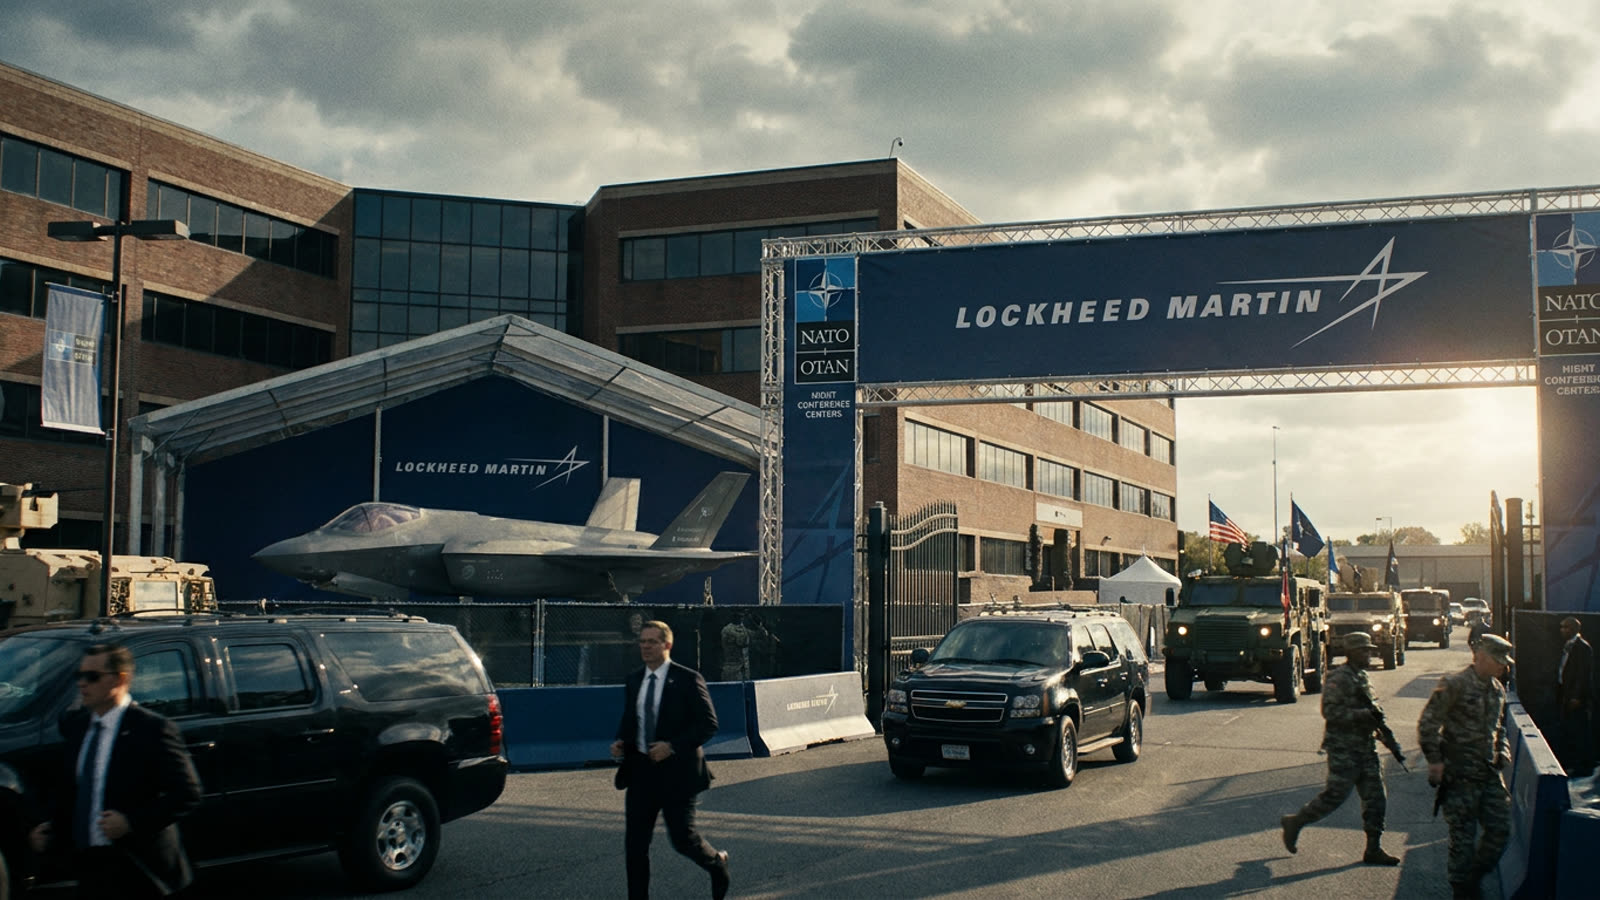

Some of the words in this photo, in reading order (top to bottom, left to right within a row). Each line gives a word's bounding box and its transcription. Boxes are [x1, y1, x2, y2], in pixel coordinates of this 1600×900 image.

[955, 298, 1150, 329] LOCKHEED
[1166, 288, 1322, 320] MARTIN
[801, 328, 849, 344] NATO
[800, 359, 849, 375] OTAN
[395, 461, 479, 474] LOCKHEED
[484, 463, 548, 476] MARTIN
